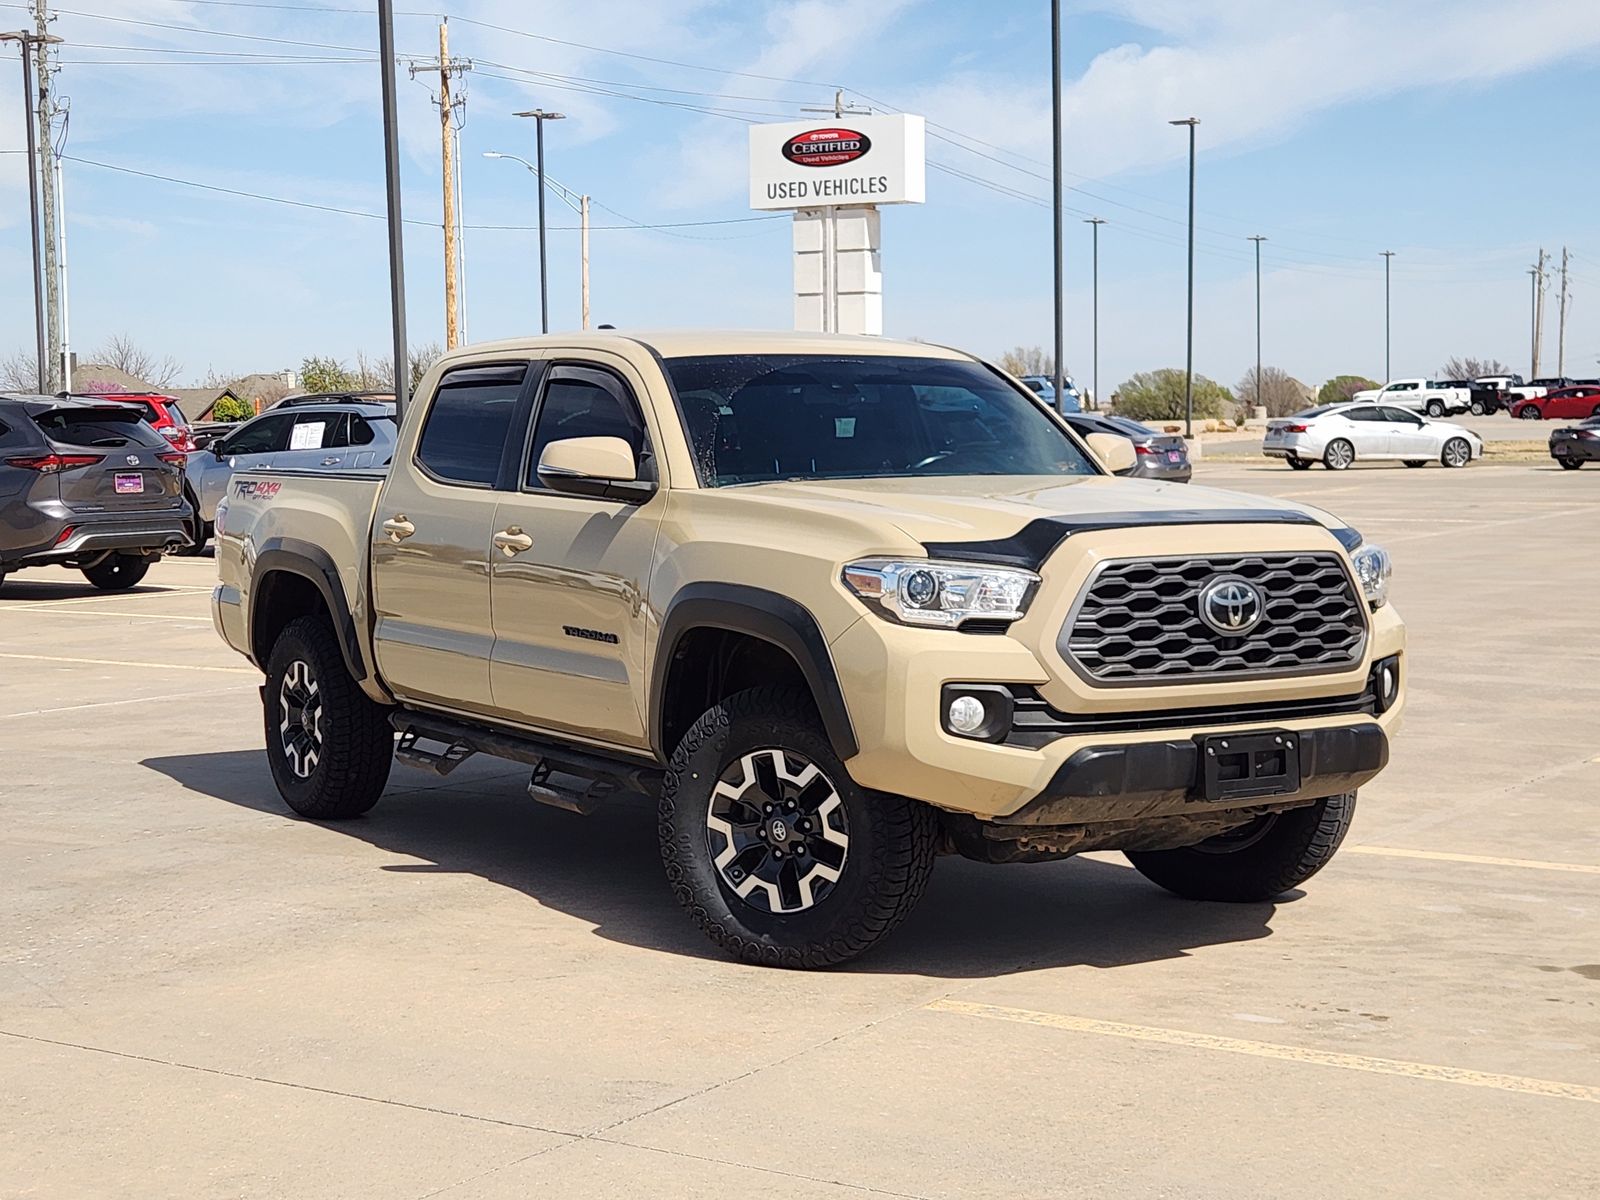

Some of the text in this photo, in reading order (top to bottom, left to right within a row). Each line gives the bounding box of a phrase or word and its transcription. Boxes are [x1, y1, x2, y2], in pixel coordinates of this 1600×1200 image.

[791, 141, 860, 155] CERTIFIED
[820, 154, 849, 162] Vehicles
[767, 176, 888, 200] USED VEHICLES
[233, 480, 258, 500] TRD
